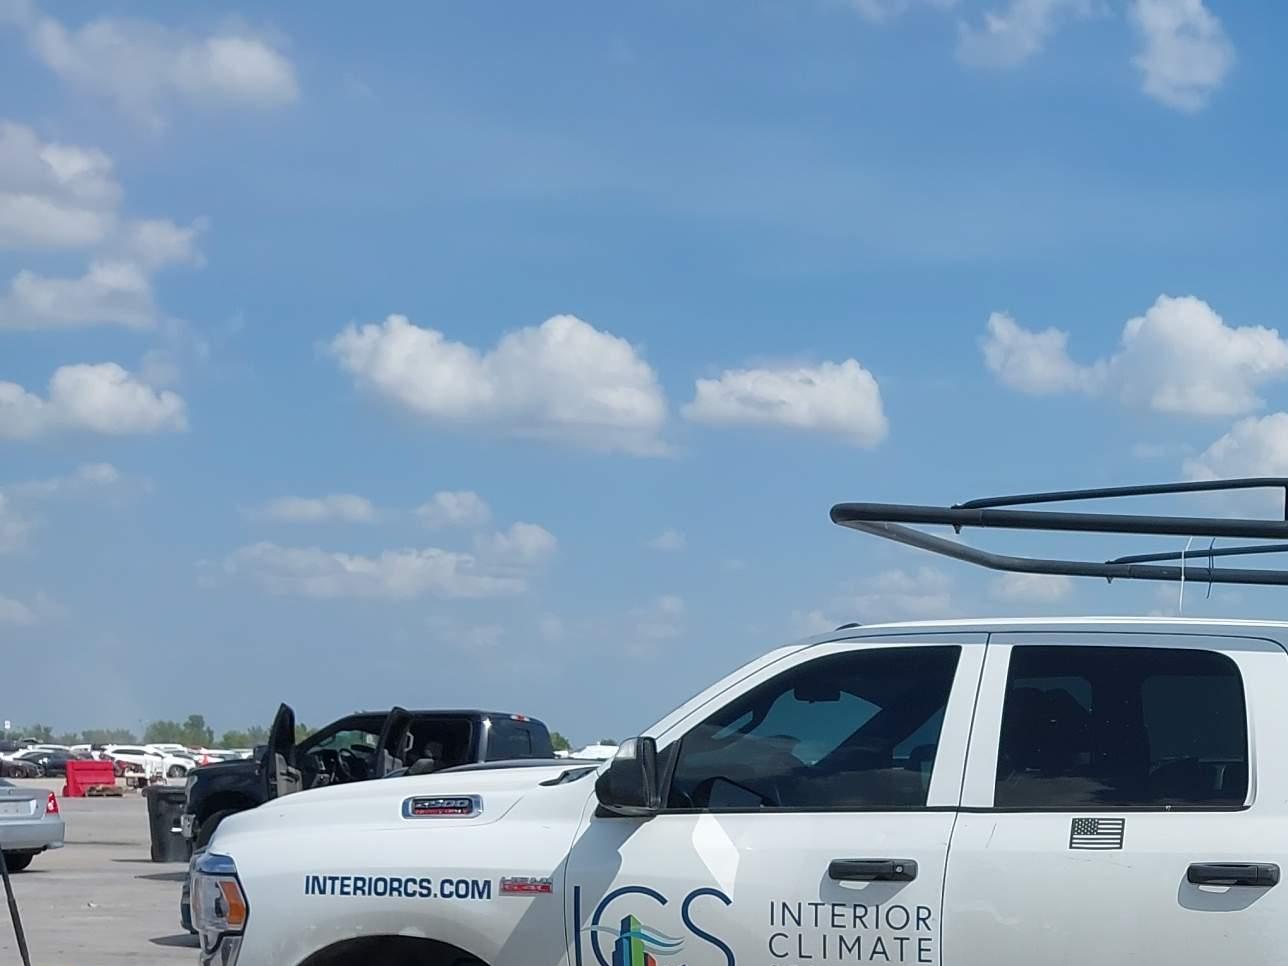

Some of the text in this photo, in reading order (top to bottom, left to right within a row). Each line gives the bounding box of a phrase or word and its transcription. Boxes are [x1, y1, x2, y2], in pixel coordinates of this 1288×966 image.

[304, 875, 492, 900] INTERIORCS.COM
[769, 901, 933, 932] INTERIOR
[768, 933, 934, 964] CLIMATE
